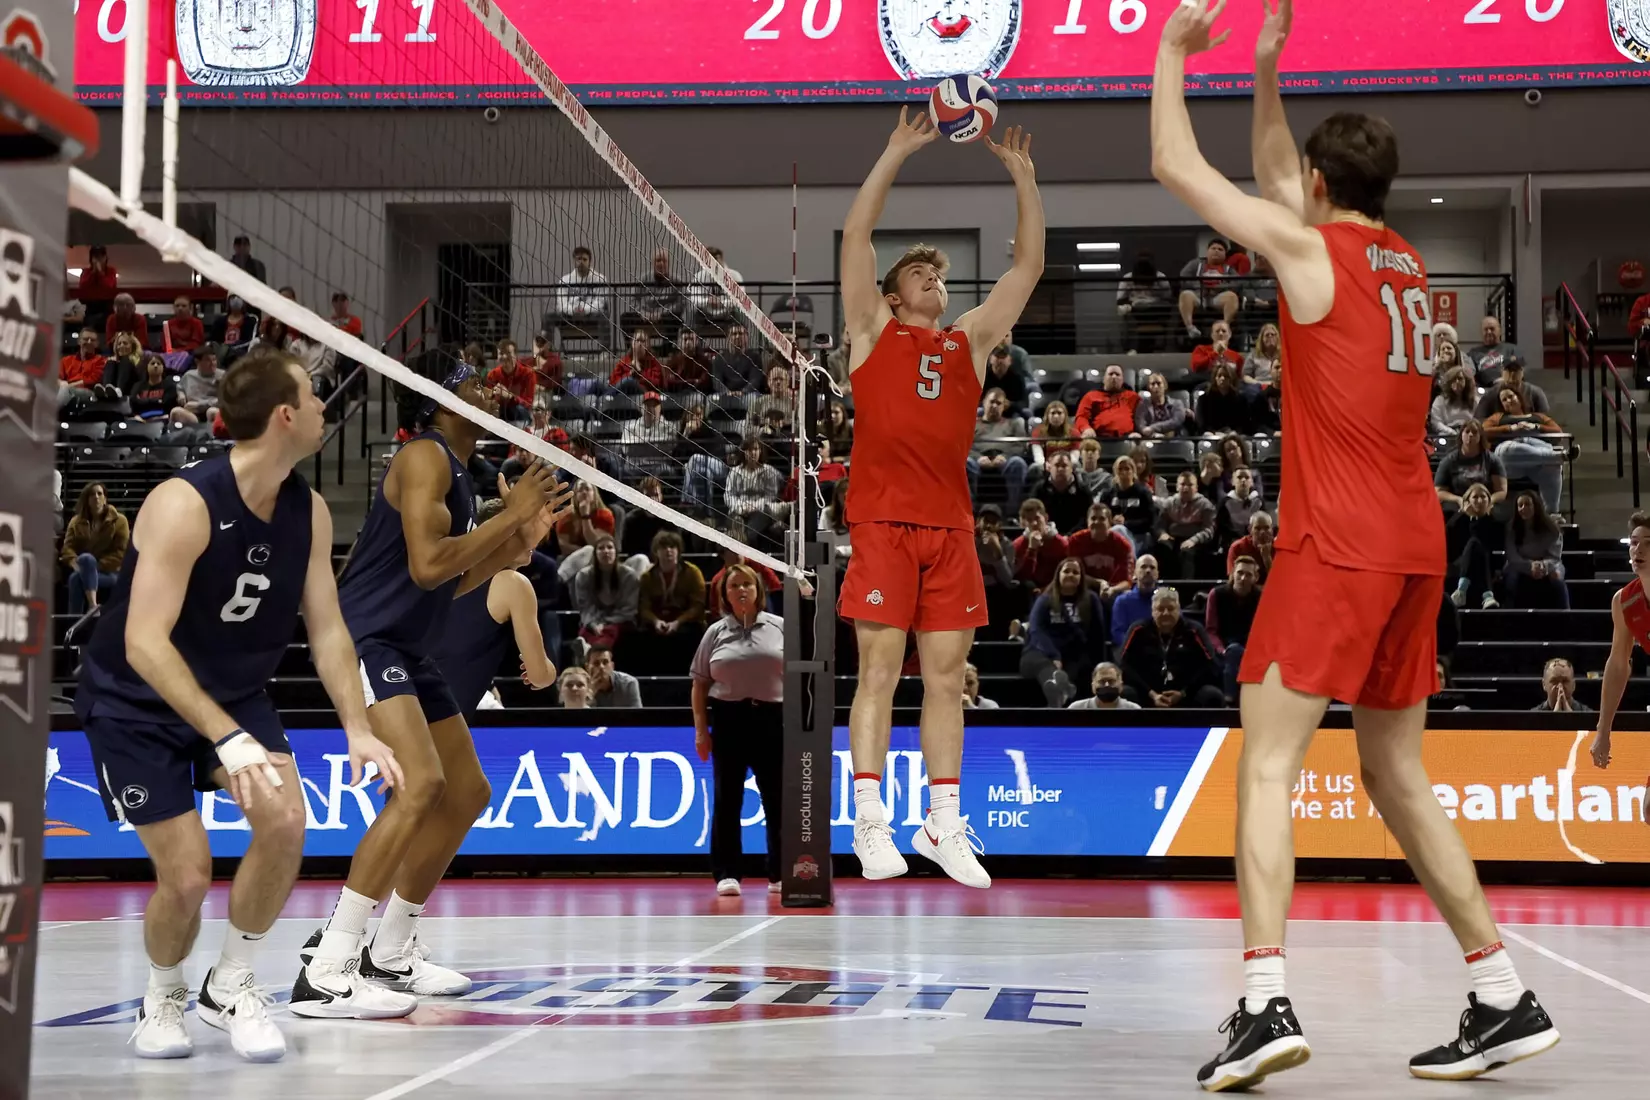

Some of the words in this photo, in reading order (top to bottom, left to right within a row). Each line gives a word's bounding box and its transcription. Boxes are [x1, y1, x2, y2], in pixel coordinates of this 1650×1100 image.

[349, 0, 437, 42] 11
[743, 0, 843, 40] 20
[1053, 0, 1148, 35] 16
[1016, 85, 1042, 93] THE
[1045, 84, 1098, 92] PEOPLE.
[1101, 83, 1127, 91] THE
[1208, 81, 1233, 89] THE
[1342, 76, 1440, 86] #GOBUCKEYES
[1459, 74, 1485, 83] THE
[1488, 73, 1544, 82] PEOPLE.
[1548, 71, 1574, 80] THE
[158, 91, 183, 100] TE
[186, 91, 239, 100] PEOPLE.
[243, 91, 267, 100] THE
[347, 91, 372, 99] THE
[588, 90, 613, 99] THE
[615, 90, 668, 98] PEOPLE.
[671, 89, 697, 98] THE
[700, 89, 771, 97] TRADITION.
[775, 89, 800, 97] THE
[803, 87, 886, 97] EXCELLENCE.
[954, 126, 979, 140] NCAA
[1379, 281, 1434, 376] 18
[916, 352, 943, 401] 5
[219, 571, 271, 623] 6
[800, 751, 813, 791] sports
[1325, 774, 1356, 794] us
[988, 784, 1063, 803] Member
[1329, 796, 1356, 819] at
[1430, 768, 1650, 822] eartlan
[799, 793, 813, 842] imports
[987, 810, 1030, 828] FDIC
